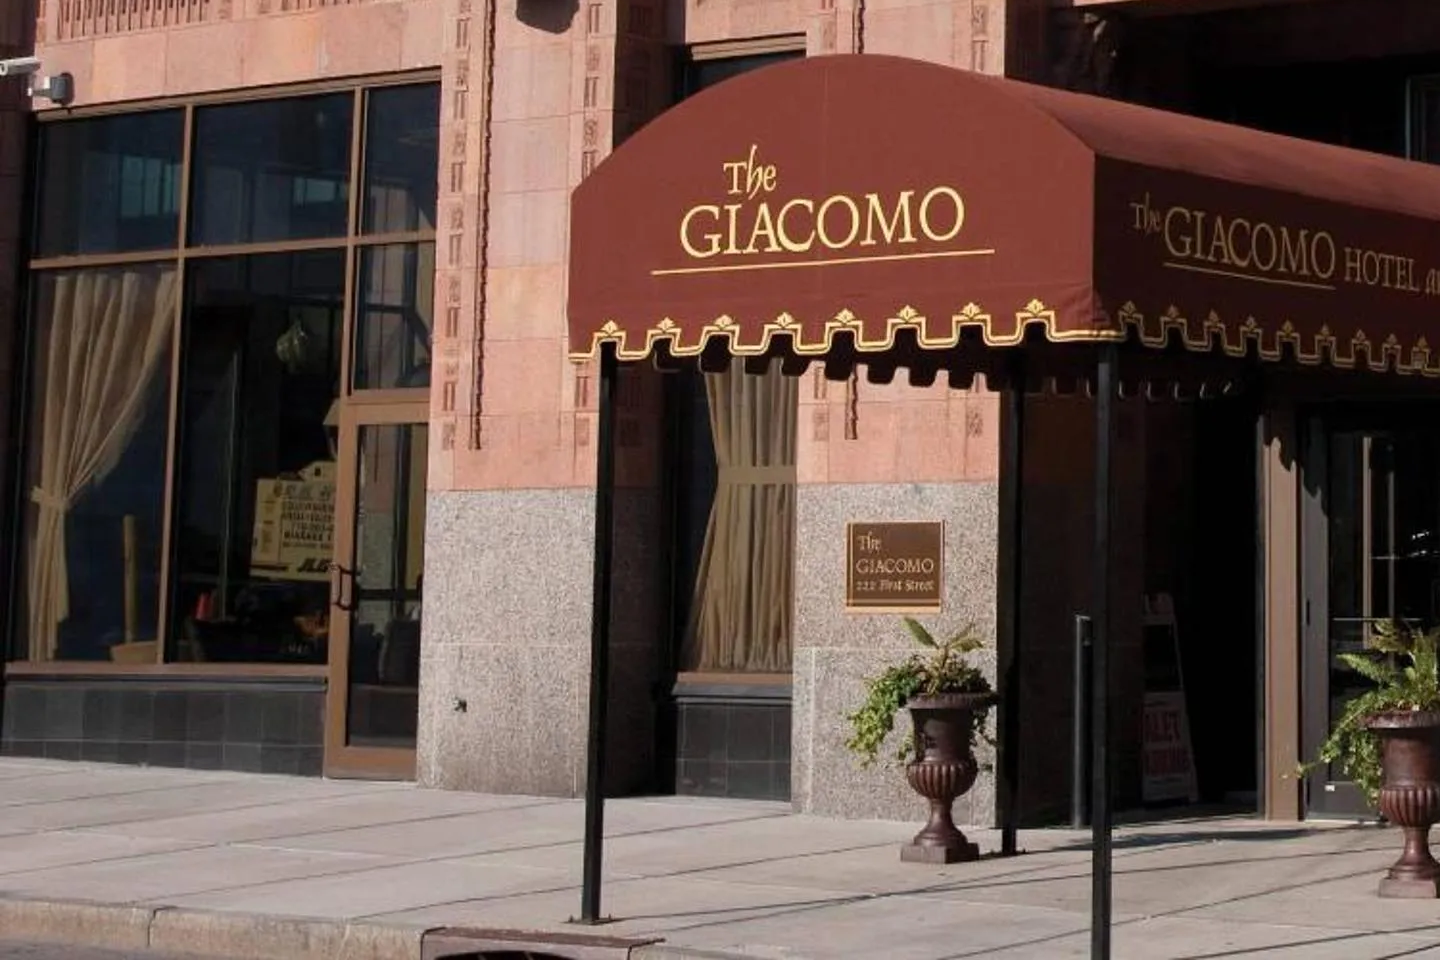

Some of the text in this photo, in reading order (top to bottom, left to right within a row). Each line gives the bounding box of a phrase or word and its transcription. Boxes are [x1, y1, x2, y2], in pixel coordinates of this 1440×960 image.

[722, 144, 777, 200] The
[679, 185, 965, 259] GIACOMO
[1128, 192, 1161, 235] The
[1164, 206, 1336, 279] GIACOMO
[1344, 246, 1420, 292] HOTEL
[855, 557, 934, 574] GIACOMO
